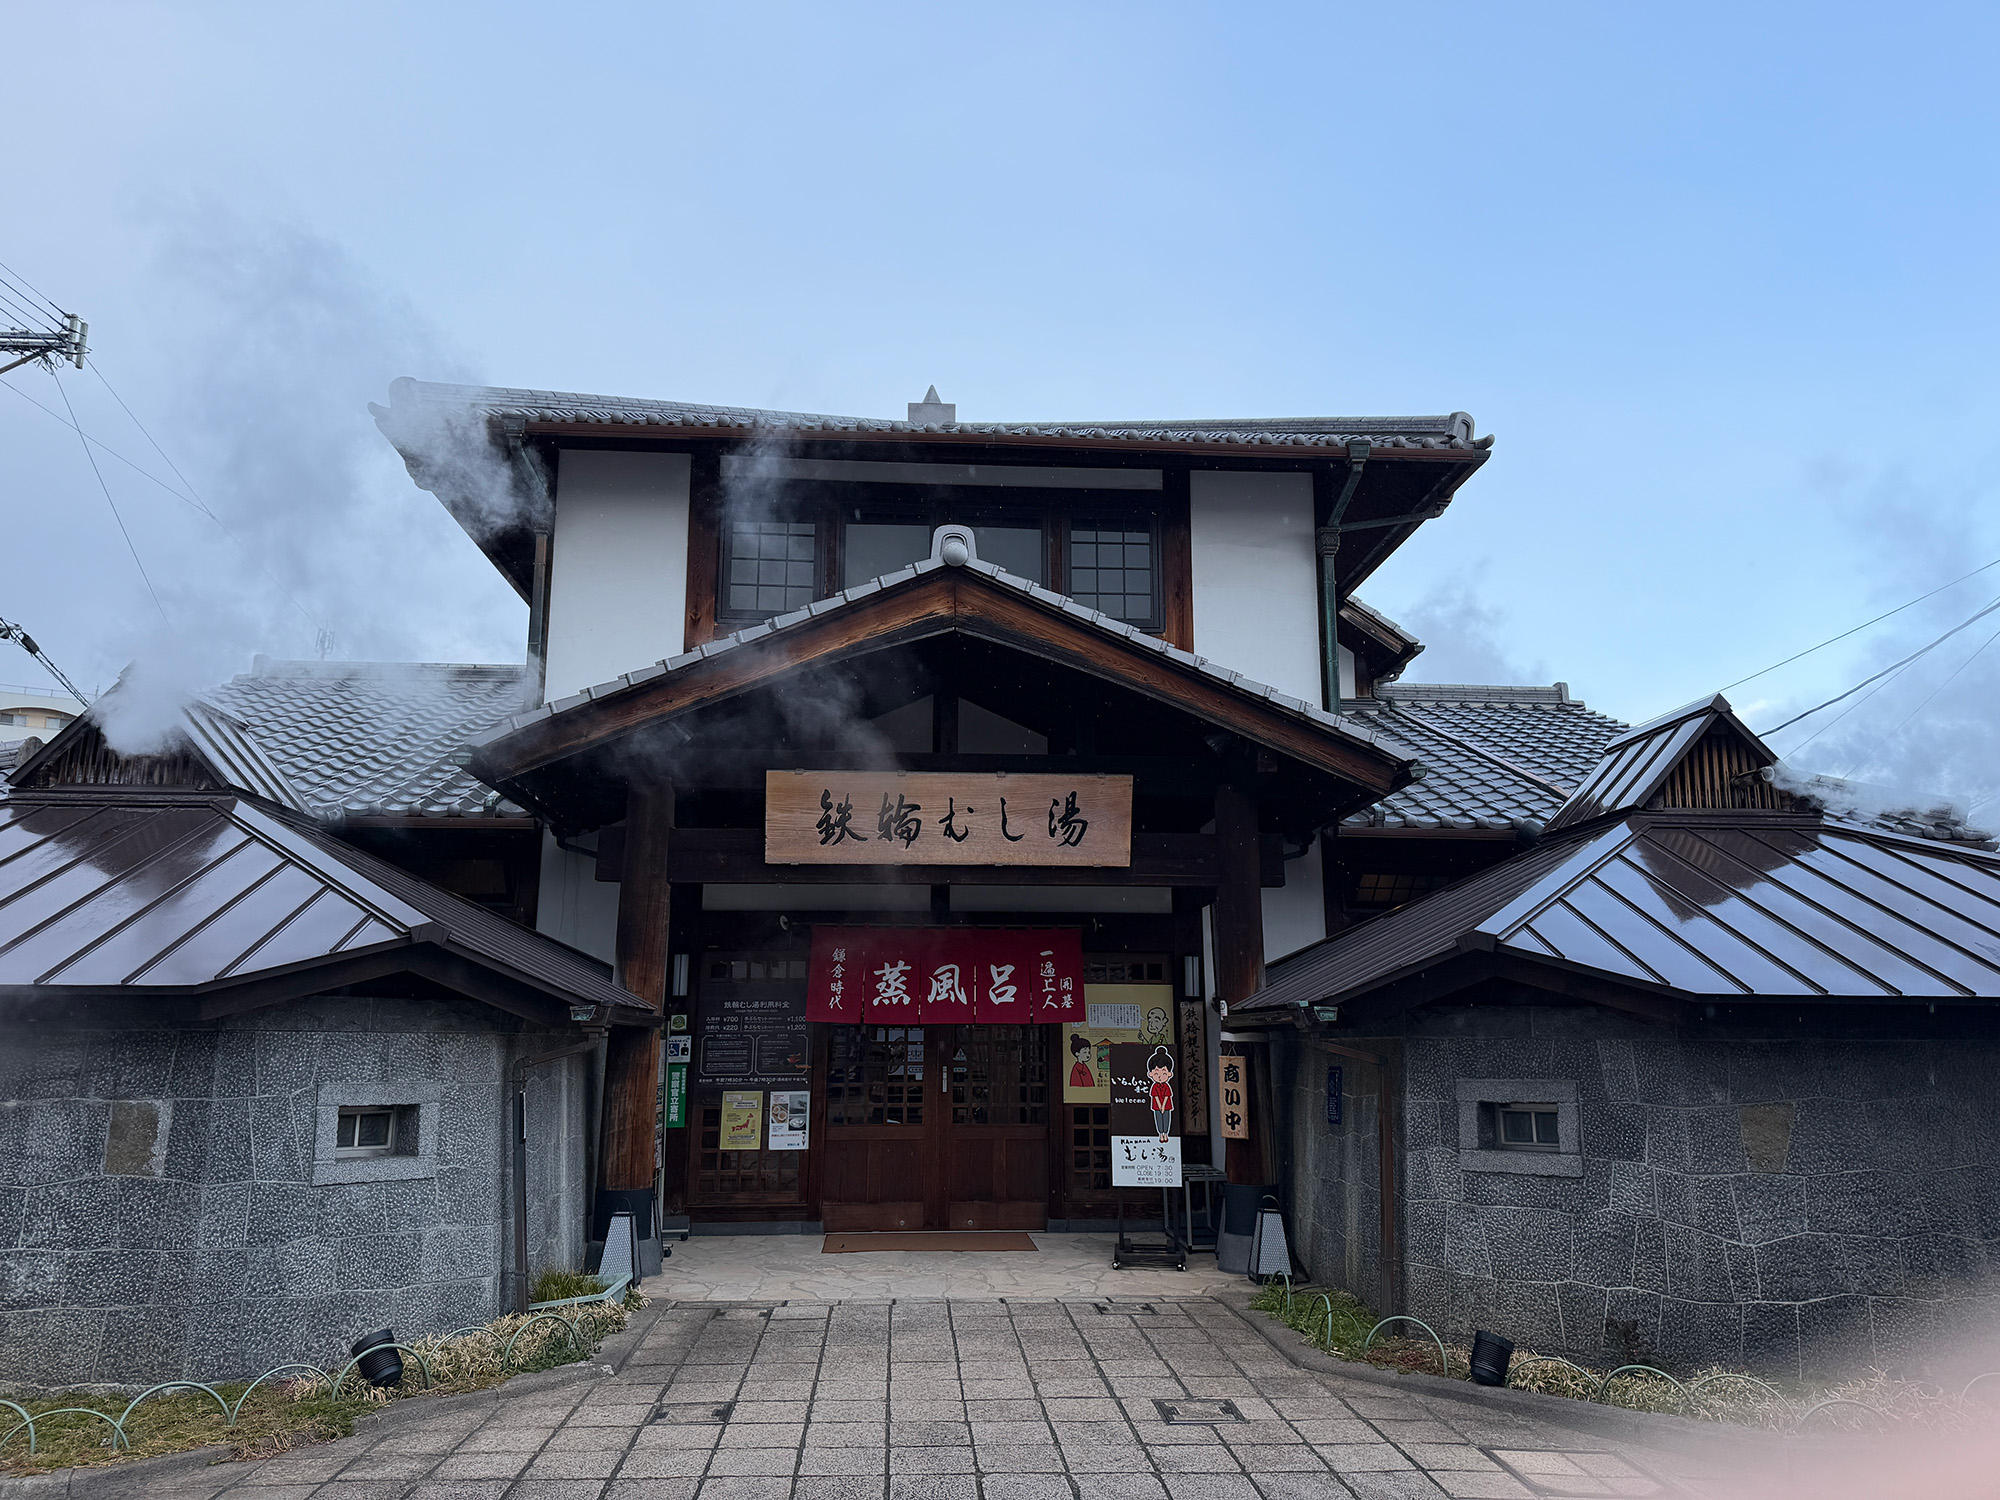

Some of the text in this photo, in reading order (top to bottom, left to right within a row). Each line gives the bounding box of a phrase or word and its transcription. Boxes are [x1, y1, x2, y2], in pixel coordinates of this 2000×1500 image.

[816, 788, 1089, 849] 鉄輪むし湯
[829, 947, 846, 1011] 鎌倉時代
[872, 959, 1018, 1007] 蒸風呂
[1039, 950, 1059, 1009] 一遍上人
[1111, 1076, 1151, 1087] いらっしゃい
[1184, 1008, 1202, 1128] 鉄輪観光交流センター
[1224, 1063, 1241, 1130] 商い中
[1124, 1145, 1168, 1163] むし湯
